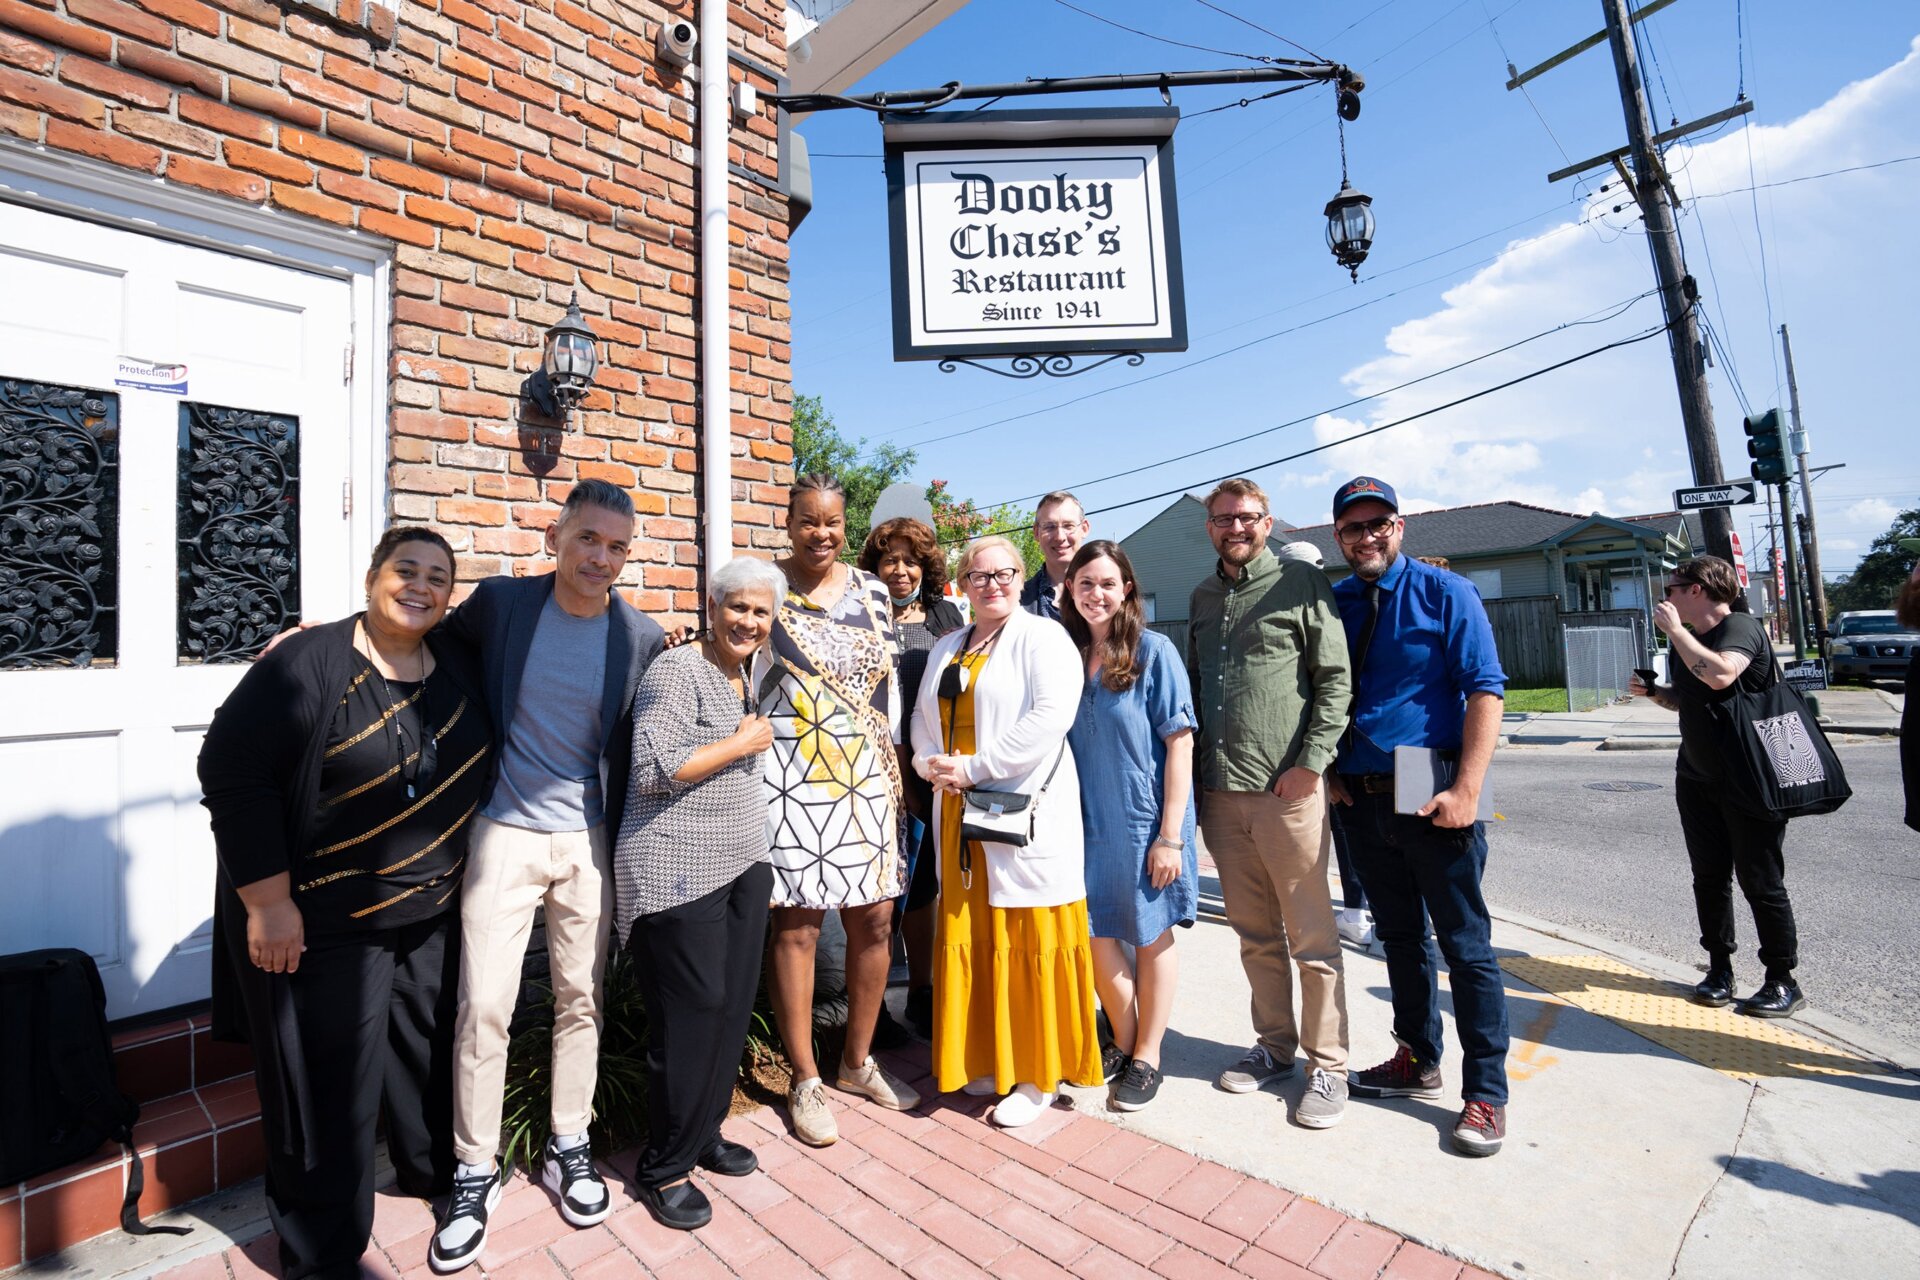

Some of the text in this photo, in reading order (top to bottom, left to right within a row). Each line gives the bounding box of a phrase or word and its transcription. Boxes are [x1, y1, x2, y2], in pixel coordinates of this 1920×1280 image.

[950, 170, 1113, 220] Dooky
[950, 220, 1121, 259] Chase's
[951, 267, 1127, 294] Restaurant
[982, 300, 1102, 322] Since 1941
[119, 364, 170, 379] Protection
[1684, 491, 1730, 504] ONE WAY
[1779, 781, 1794, 789] OFF
[1808, 775, 1826, 783] WALL
